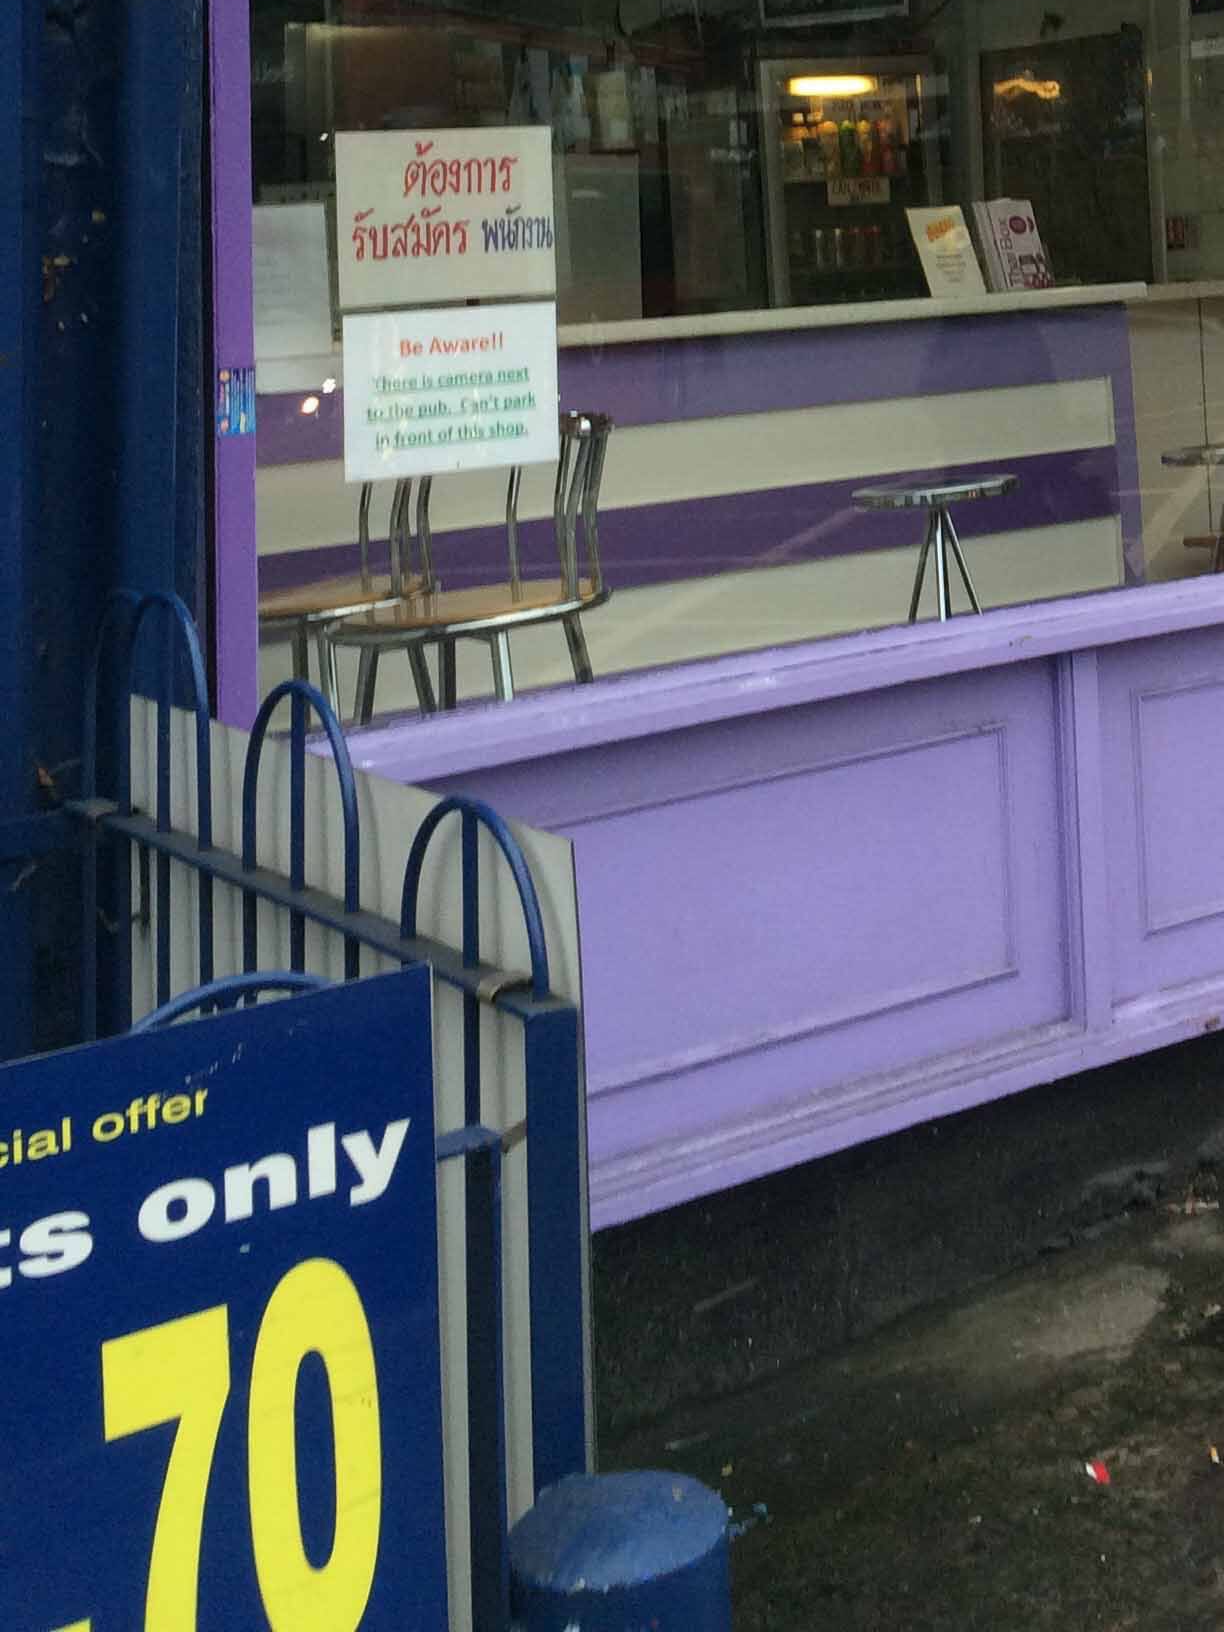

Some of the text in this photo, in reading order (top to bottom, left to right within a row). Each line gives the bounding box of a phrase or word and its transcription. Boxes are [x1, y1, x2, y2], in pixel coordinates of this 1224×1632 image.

[399, 339, 423, 357] Be
[437, 370, 494, 388] camera
[497, 366, 530, 383] next
[367, 405, 384, 420] to
[504, 391, 537, 412] park
[394, 427, 434, 449] front
[92, 1088, 208, 1143] offer
[138, 1119, 411, 1243] only
